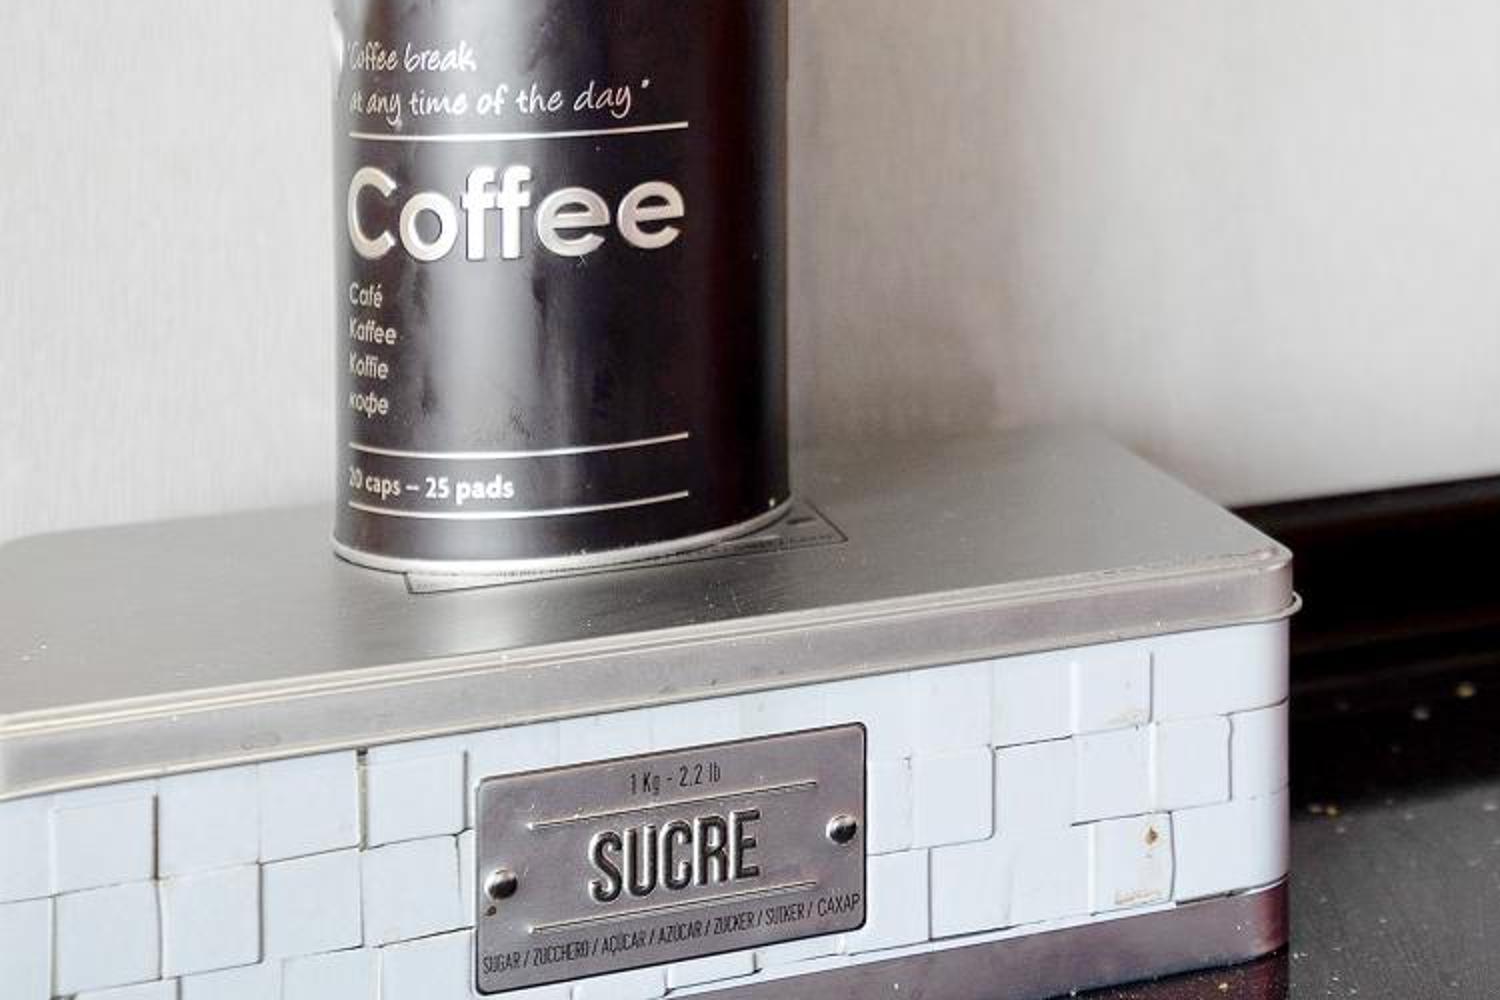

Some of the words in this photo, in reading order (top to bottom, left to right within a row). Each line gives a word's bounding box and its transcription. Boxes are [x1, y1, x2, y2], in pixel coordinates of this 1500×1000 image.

[403, 39, 477, 72] break
[365, 92, 402, 128] any
[409, 88, 468, 116] time
[477, 86, 509, 116] of
[515, 83, 563, 113] the
[348, 166, 685, 262] Coffee
[349, 282, 383, 309] Café
[349, 317, 397, 345] Kaffee
[349, 351, 389, 379] Koffie
[365, 475, 401, 501] caps
[425, 475, 449, 499] 25
[455, 473, 515, 506] pads
[630, 773, 637, 796] 1
[643, 771, 660, 797] Kg
[680, 763, 703, 788] 2.2
[709, 761, 720, 782] lb
[588, 808, 761, 903] SUCRE
[483, 952, 522, 975] SUGAR
[533, 939, 589, 967] ZUCCHERO
[713, 911, 755, 936] ZUCKER
